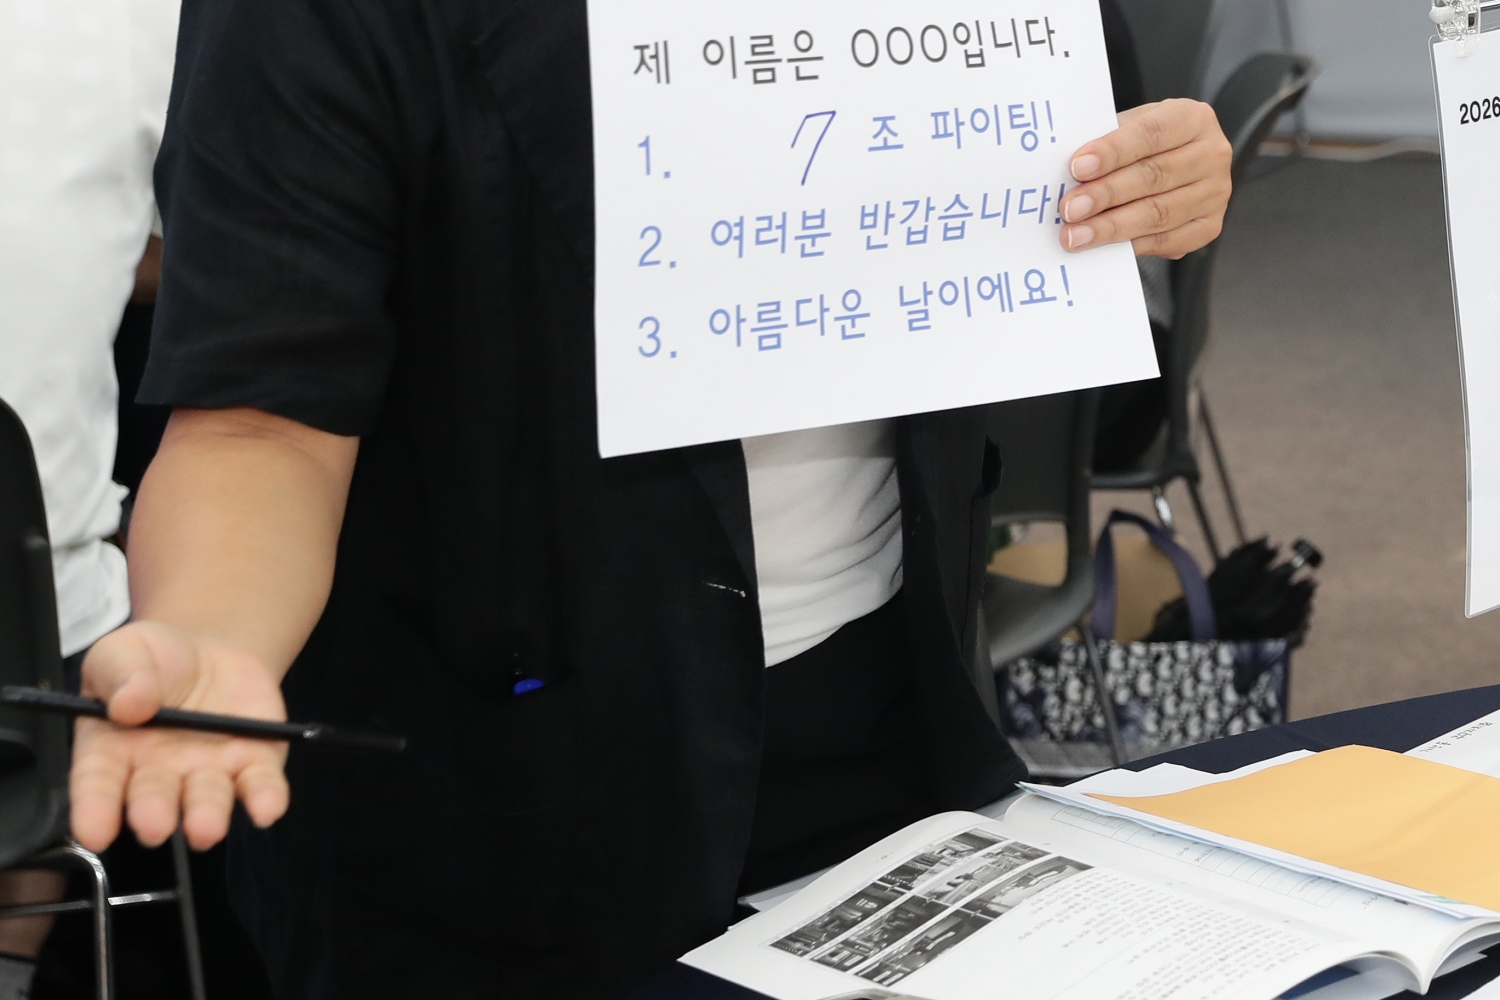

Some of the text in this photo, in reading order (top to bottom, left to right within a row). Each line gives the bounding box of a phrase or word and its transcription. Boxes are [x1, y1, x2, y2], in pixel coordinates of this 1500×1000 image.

[632, 40, 672, 85] 제
[702, 29, 825, 85] 이름은
[637, 99, 1058, 186] 1. 7 조 파이팅!
[637, 182, 1067, 268] 2. 여러분 반갑습니다!
[637, 264, 1074, 359] 3. 아름다운 날이에요!
